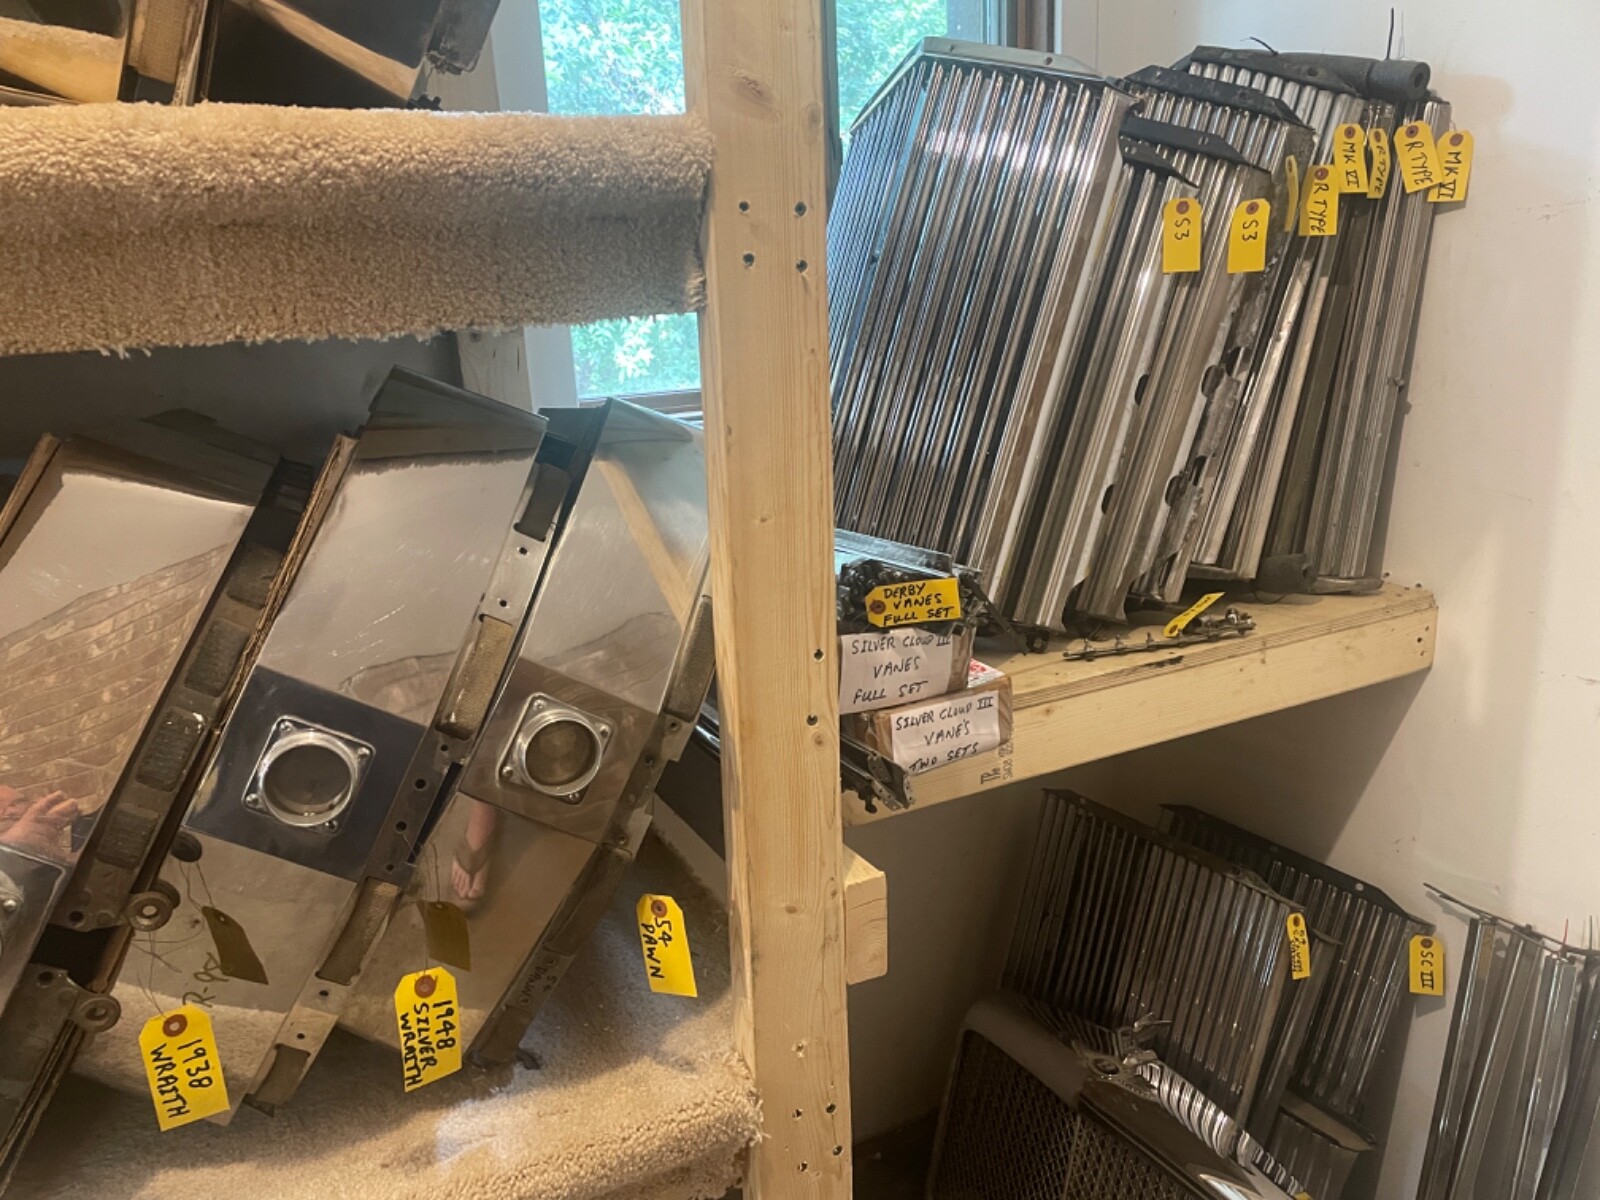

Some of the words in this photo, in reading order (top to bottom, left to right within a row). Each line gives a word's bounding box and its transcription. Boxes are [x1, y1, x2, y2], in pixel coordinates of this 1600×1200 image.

[1343, 142, 1356, 165] MK
[1405, 140, 1425, 151] R
[1411, 153, 1434, 186] TYPE
[1443, 151, 1463, 177] MK
[1313, 183, 1329, 194] R
[1375, 161, 1386, 193] TYPE
[1437, 178, 1457, 199] VI
[1308, 199, 1328, 234] TYPE
[1174, 219, 1191, 241] S3
[1242, 219, 1259, 242] S3
[884, 582, 926, 599] DERBY
[893, 593, 942, 610] VANES
[884, 612, 918, 627] FULL
[927, 606, 955, 619] SET
[851, 636, 896, 655] SILVER
[902, 635, 934, 648] CLOUD
[873, 656, 921, 679] VANES
[853, 688, 887, 705] FULL
[898, 680, 929, 698] SET
[895, 710, 935, 731] SILVER
[939, 703, 973, 720] CLOUD
[976, 696, 995, 711] III
[909, 757, 938, 771] TWO
[947, 742, 979, 761] SETS
[641, 923, 665, 979] DAWN
[1420, 950, 1434, 966] SC
[1420, 971, 1434, 991] III
[413, 1003, 438, 1070] SILVER
[432, 1000, 457, 1050] 1948
[400, 1013, 423, 1089] WRAITH
[177, 1039, 214, 1089] 1938
[150, 1043, 191, 1119] WRAITH
